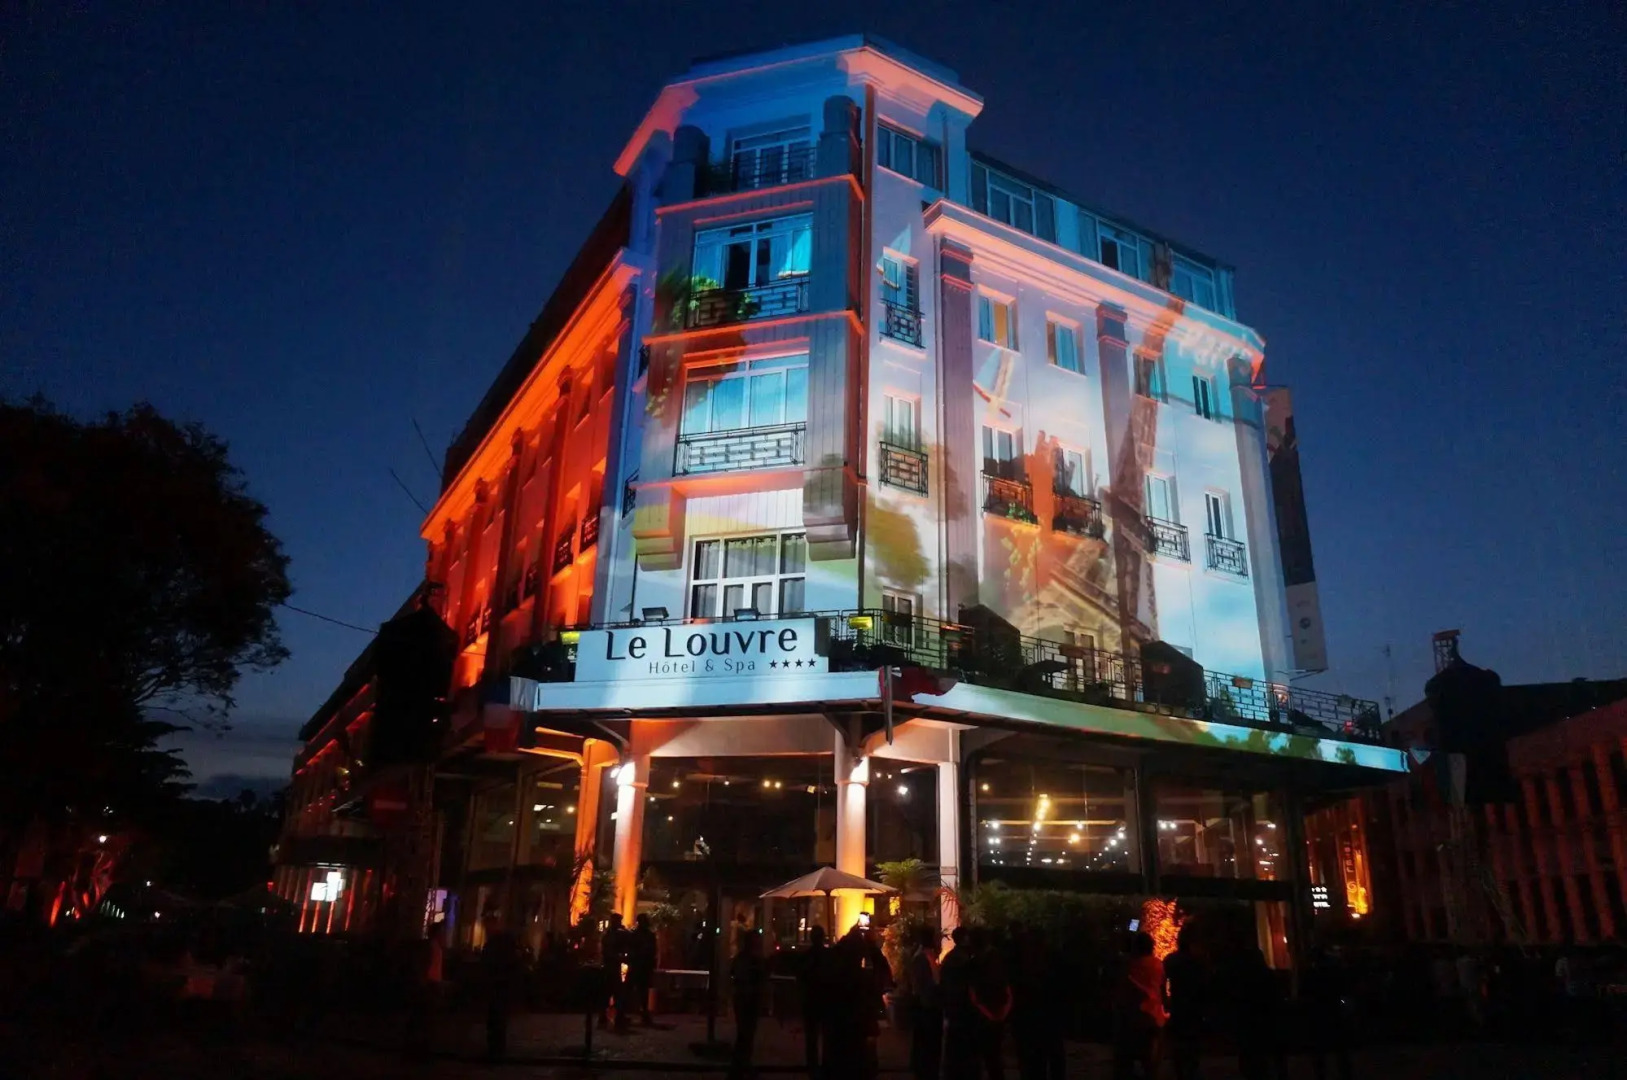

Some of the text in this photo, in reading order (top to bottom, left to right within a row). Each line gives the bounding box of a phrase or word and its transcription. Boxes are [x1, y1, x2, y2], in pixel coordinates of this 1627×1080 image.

[605, 627, 798, 660] Le Louvre
[648, 658, 756, 674] Hôtel & Spa
